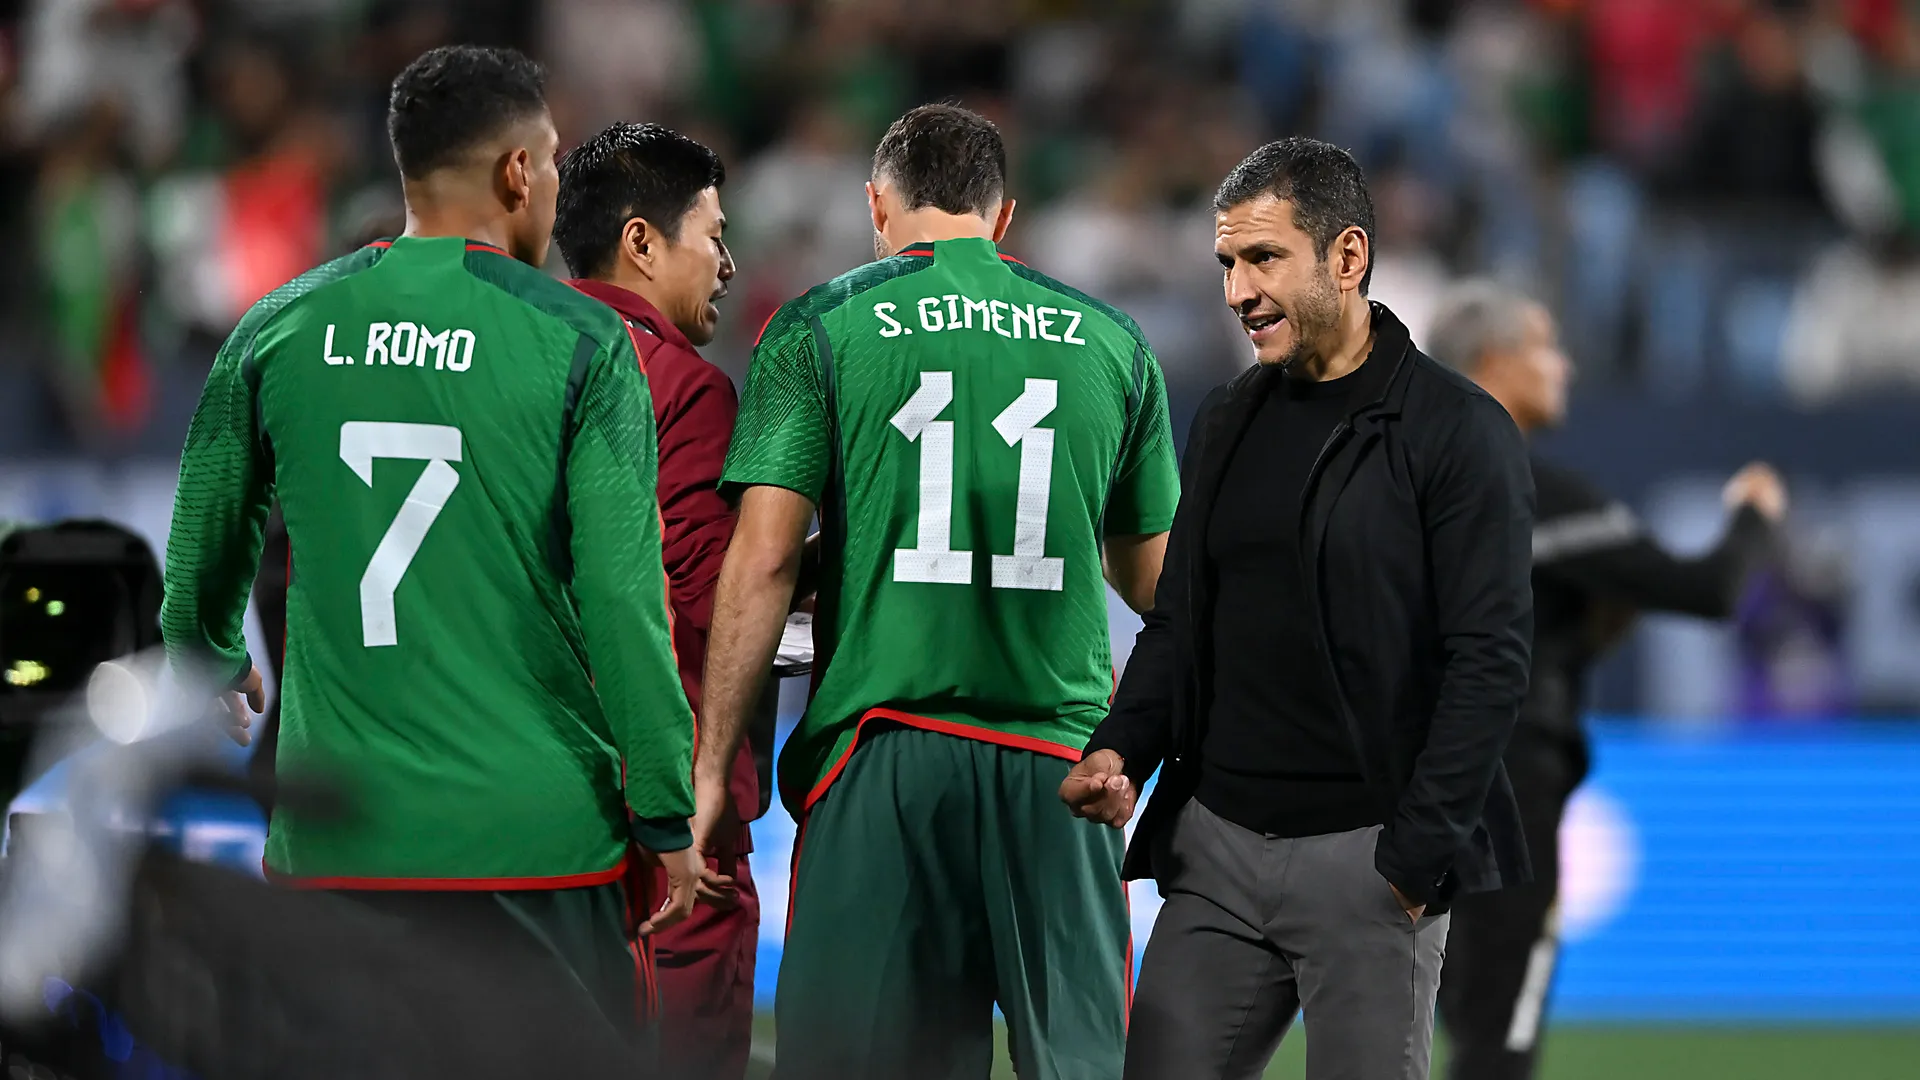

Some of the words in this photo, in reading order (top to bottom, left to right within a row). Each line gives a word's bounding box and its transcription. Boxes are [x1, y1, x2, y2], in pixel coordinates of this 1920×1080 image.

[323, 324, 355, 366] L.
[365, 321, 476, 373] ROMO
[873, 301, 913, 338] S.
[917, 294, 1086, 346] GIMENEZ
[339, 421, 463, 648] 7
[888, 371, 1065, 592] 11
